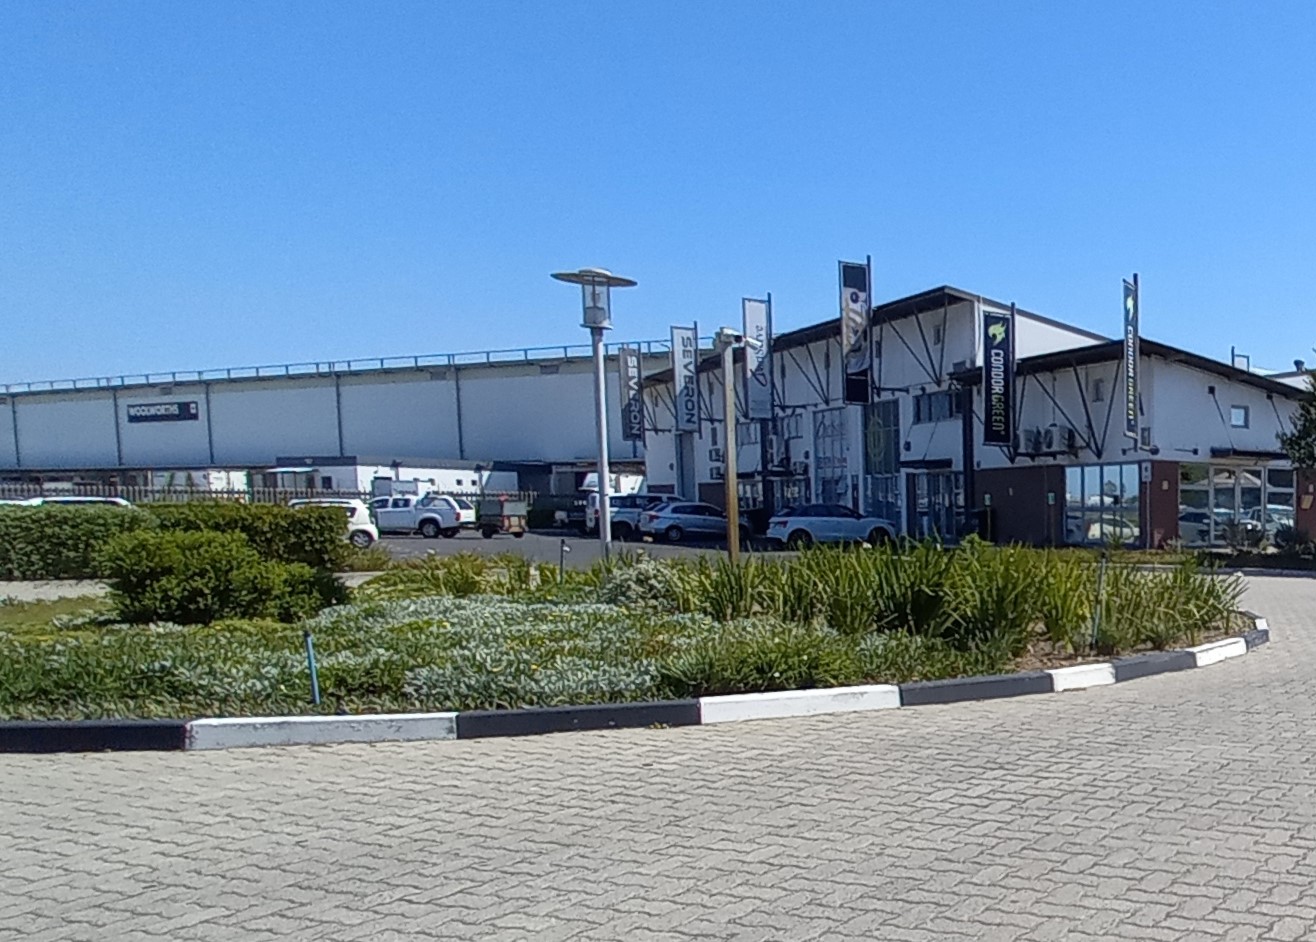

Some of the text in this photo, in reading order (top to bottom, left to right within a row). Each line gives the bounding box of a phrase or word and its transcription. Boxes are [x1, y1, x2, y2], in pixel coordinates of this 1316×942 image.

[627, 355, 641, 436] SEVERON
[681, 336, 697, 424] SEVERON
[991, 349, 1005, 431] CONDOR GREEN
